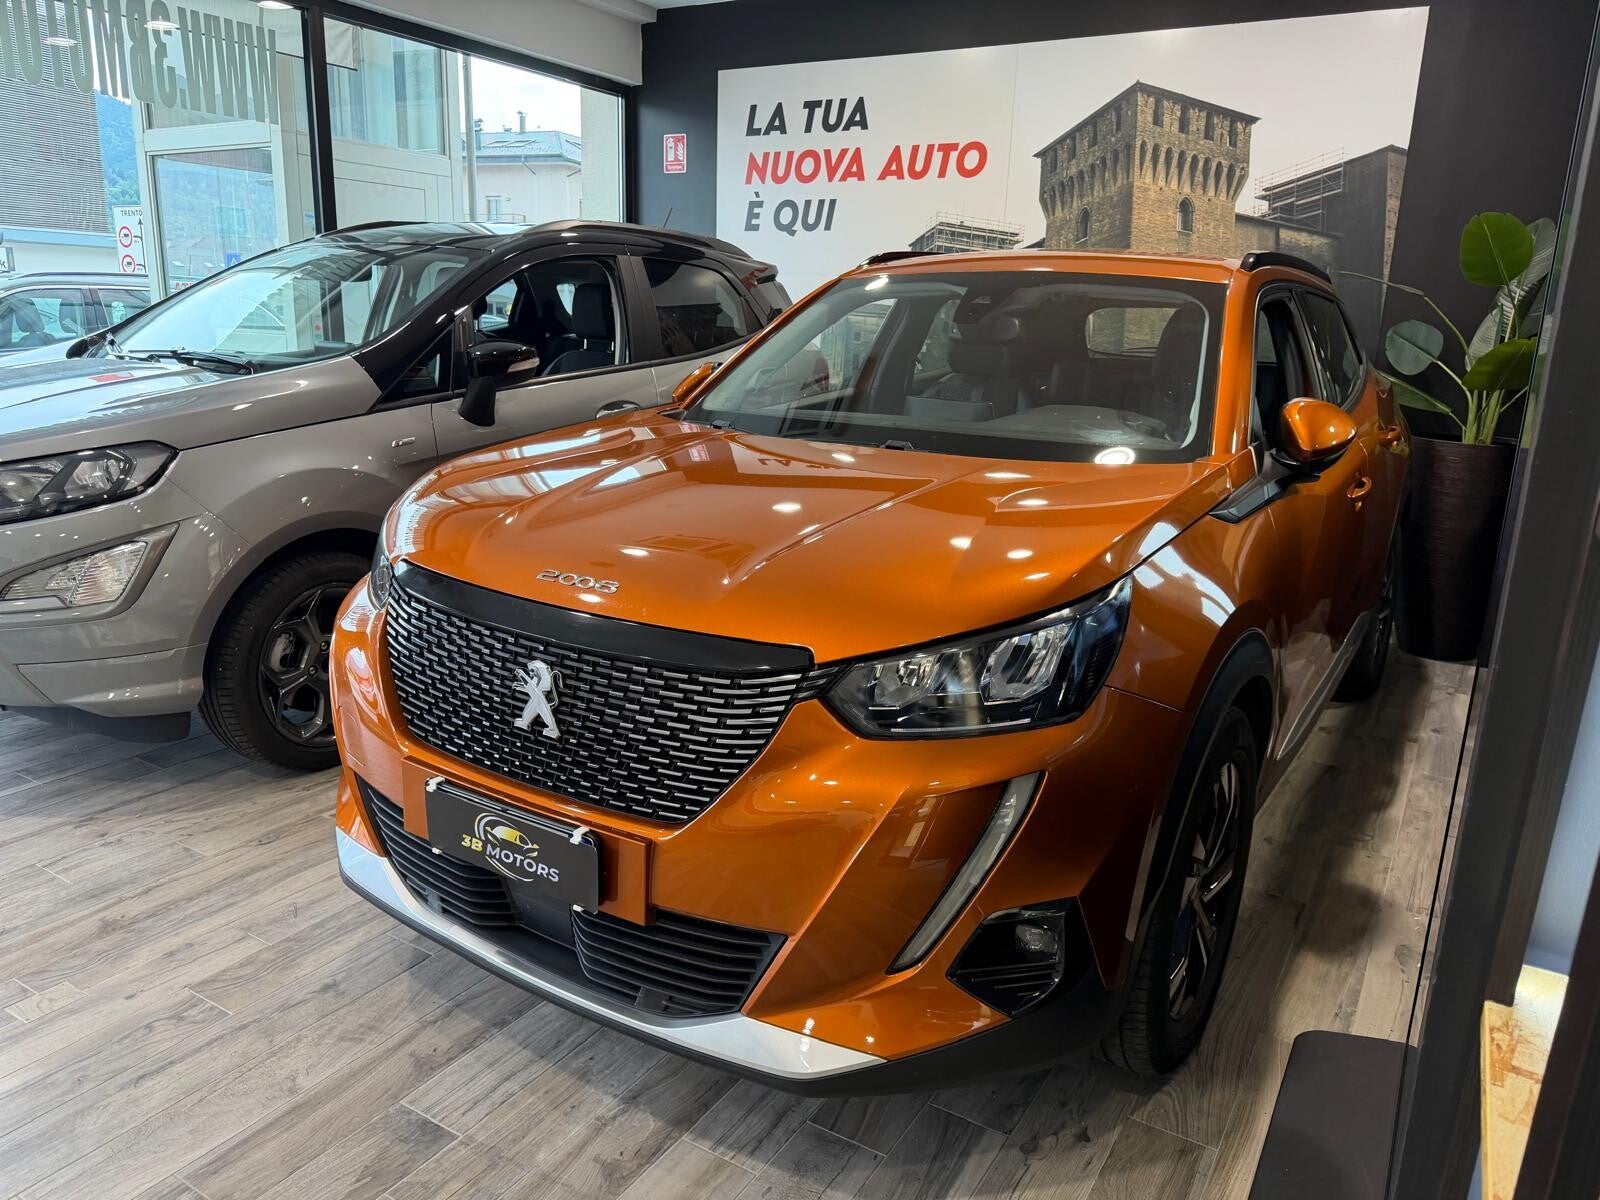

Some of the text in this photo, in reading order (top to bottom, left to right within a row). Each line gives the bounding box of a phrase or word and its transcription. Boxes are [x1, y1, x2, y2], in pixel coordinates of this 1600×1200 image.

[746, 96, 869, 137] LA TUA
[744, 141, 988, 185] NUOVA AUTO
[120, 209, 143, 217] TRENTO
[744, 191, 837, 237] È QUI
[536, 569, 620, 594] 2008
[461, 833, 560, 883] 3B MOTORS
